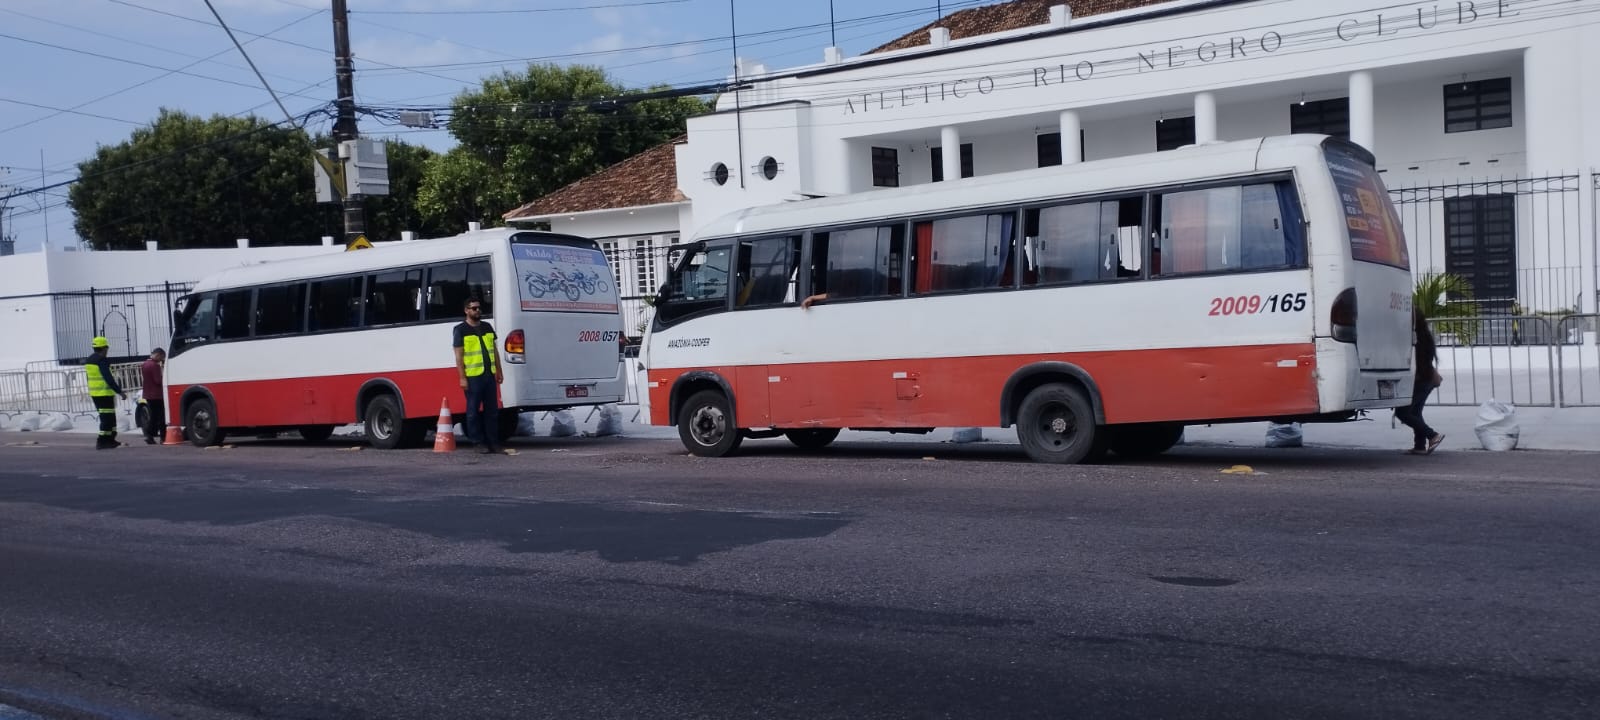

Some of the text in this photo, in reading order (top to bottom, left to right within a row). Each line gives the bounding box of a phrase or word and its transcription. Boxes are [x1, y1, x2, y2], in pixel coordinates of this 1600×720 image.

[843, 1, 1521, 116] ATLETICO RIO NEGRO CLUBE
[1208, 292, 1307, 316] 2009/165
